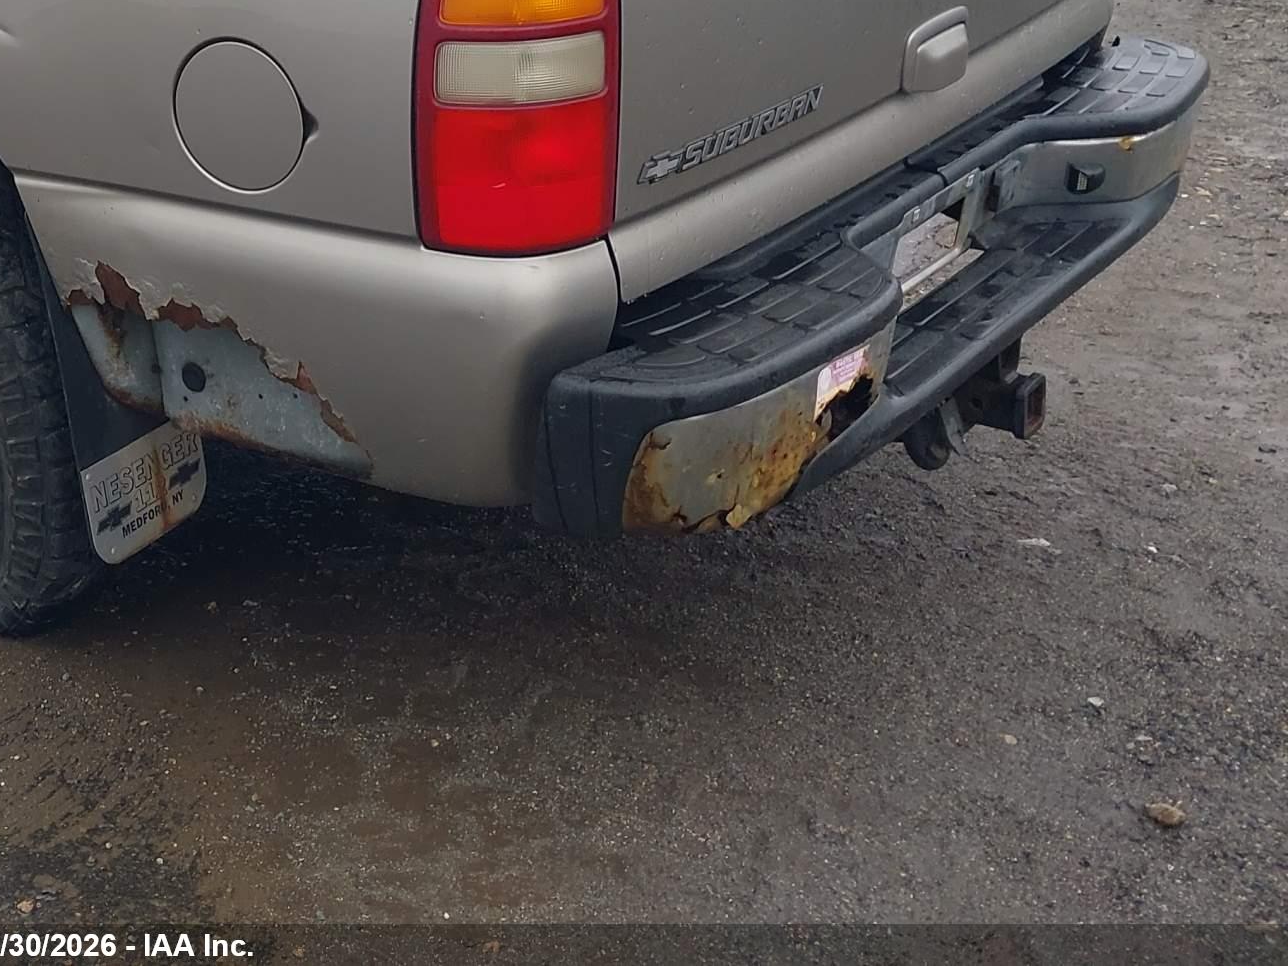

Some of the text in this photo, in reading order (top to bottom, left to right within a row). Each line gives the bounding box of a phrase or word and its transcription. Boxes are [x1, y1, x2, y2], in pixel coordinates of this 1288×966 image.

[680, 83, 824, 173] SUBURBAN
[90, 432, 199, 513] NESENGER
[172, 489, 184, 506] NY
